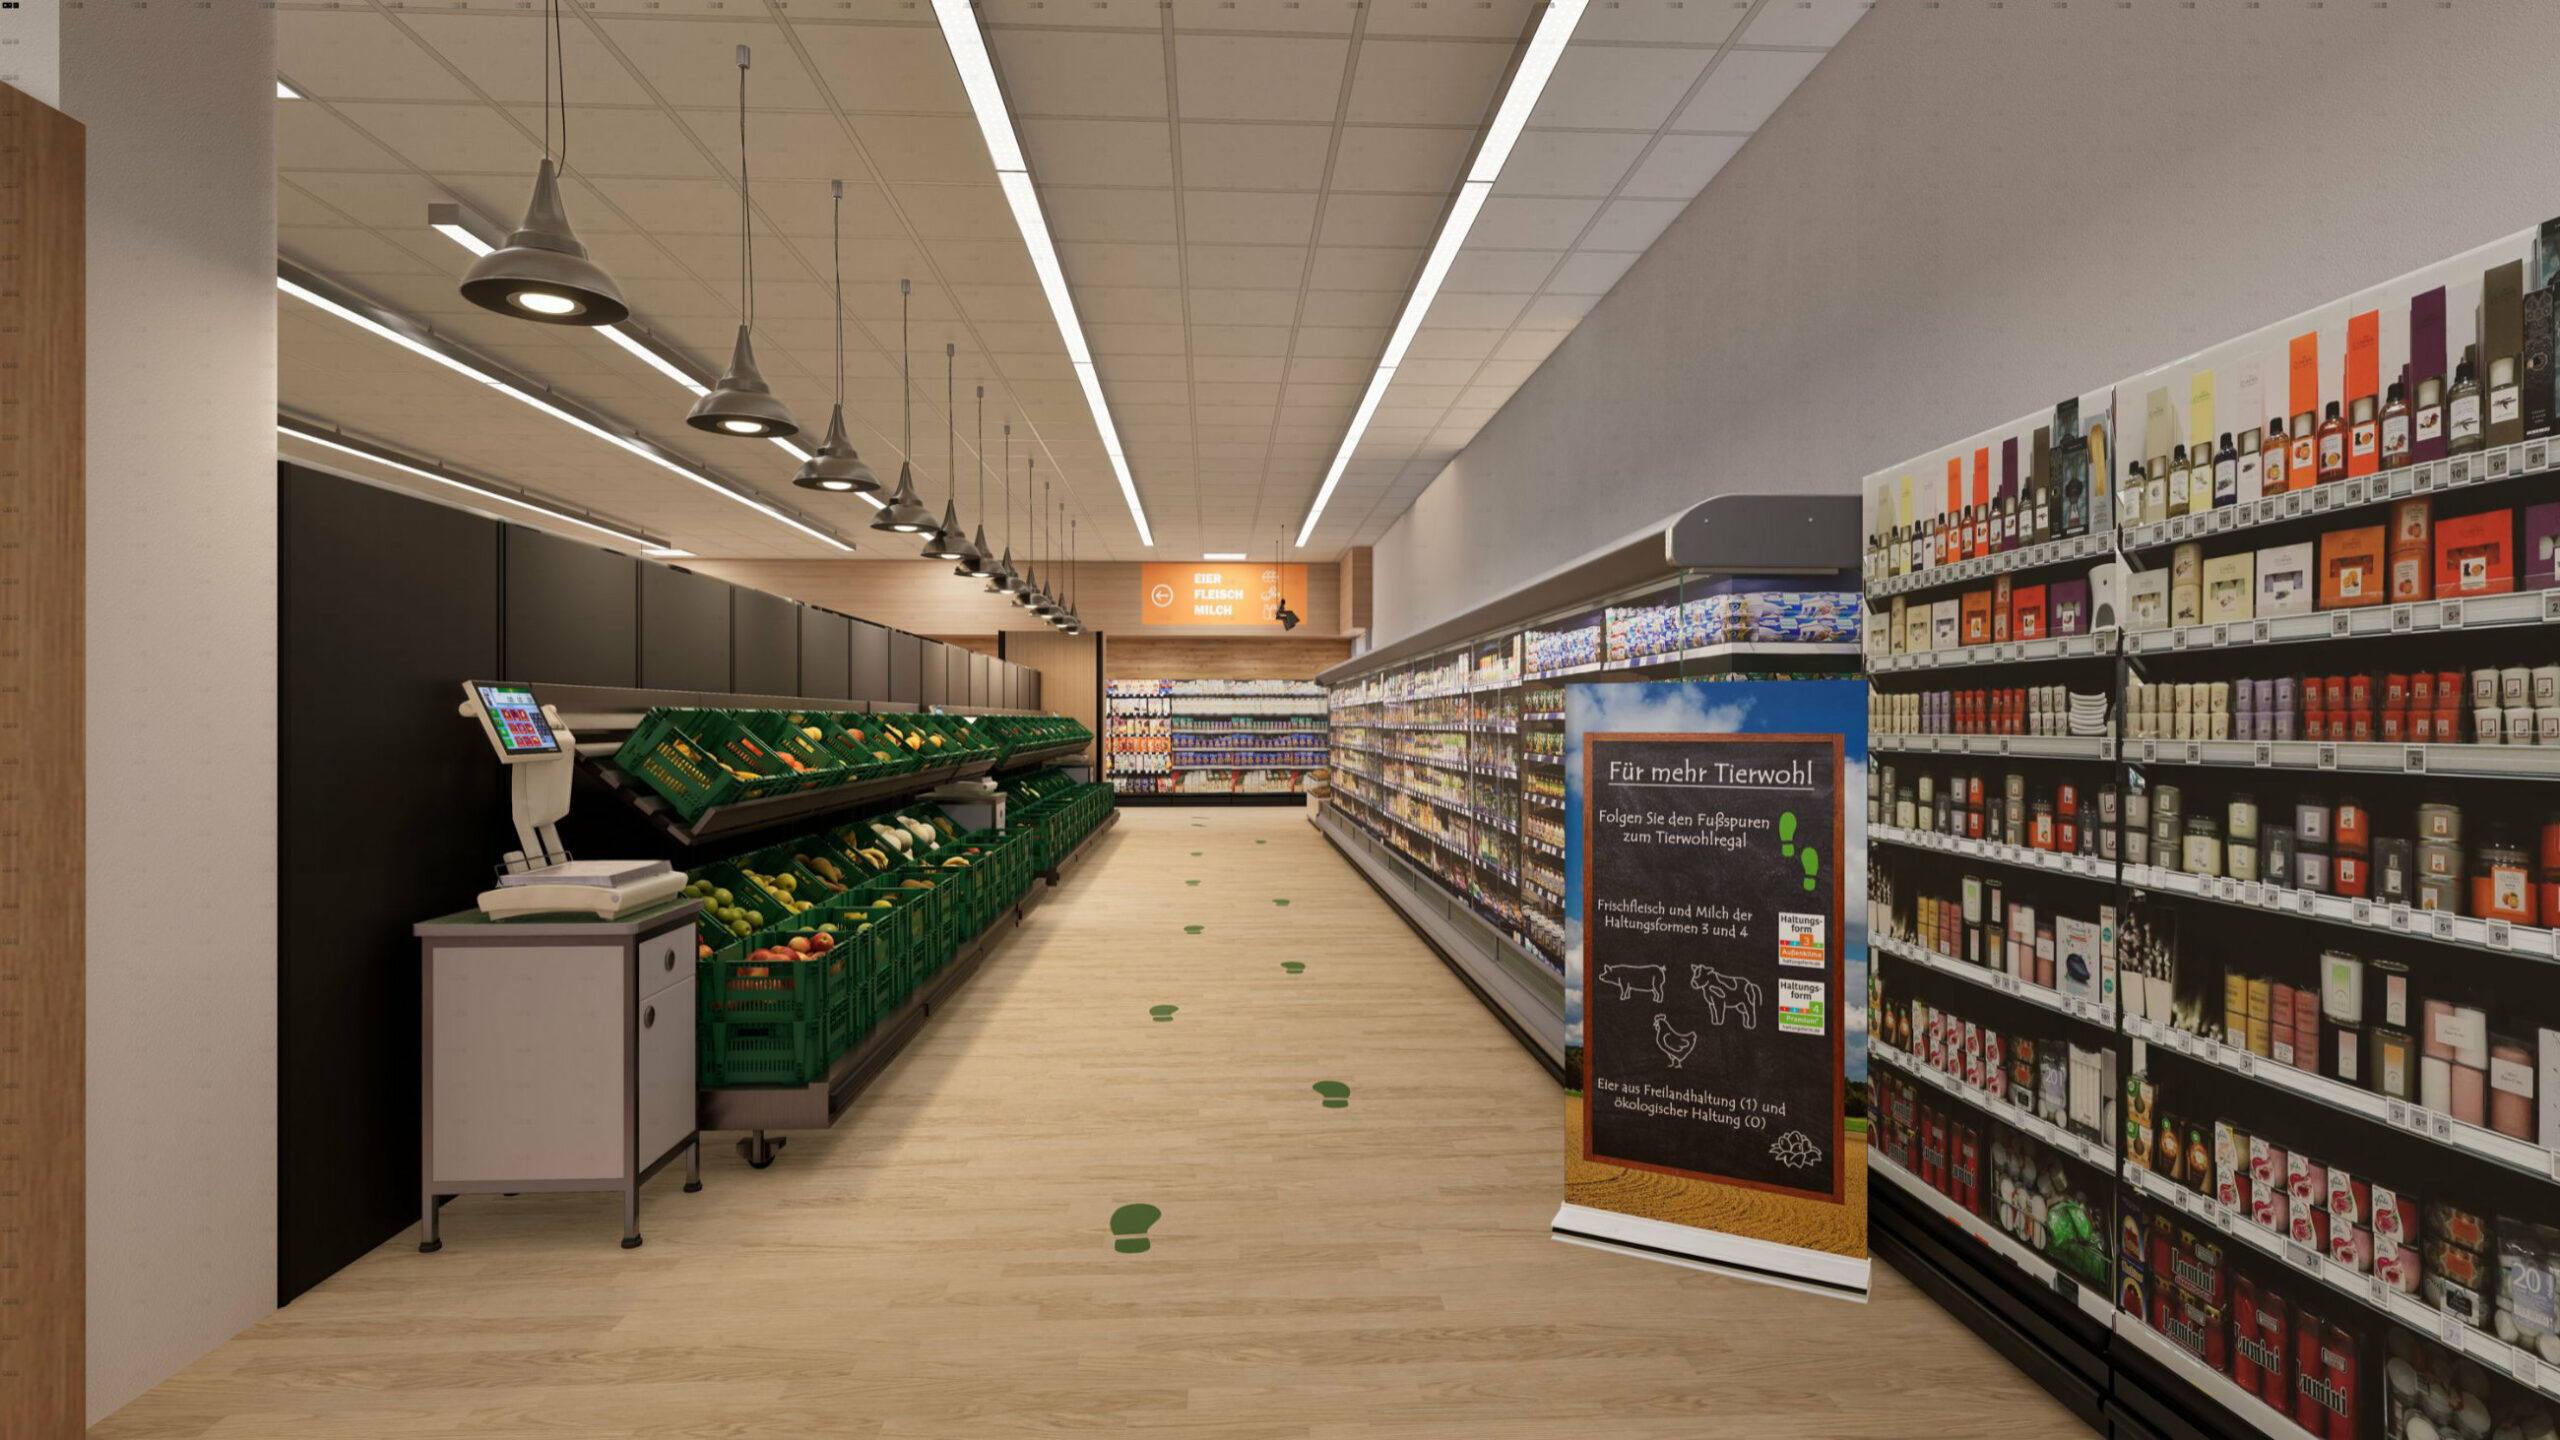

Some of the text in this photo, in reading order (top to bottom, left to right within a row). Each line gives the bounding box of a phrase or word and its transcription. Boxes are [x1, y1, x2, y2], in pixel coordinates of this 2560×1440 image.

[1194, 573, 1222, 585] EIER
[1194, 589, 1244, 600] FLEISCH
[1194, 605, 1233, 616] MILCH
[1609, 758, 1813, 786] Für mehr Tierwohl
[1599, 808, 1770, 833] Folgen Sie den Fußspuren
[1623, 828, 1747, 852] zum Tierwohlregal
[1597, 899, 1753, 921] Frischfleisch und Milch der
[1605, 914, 1749, 938] Haltungsformen 3 und 4
[1780, 915, 1823, 926] Haltungs-
[1791, 925, 1813, 934] form
[1803, 936, 1810, 946] 3
[1780, 981, 1823, 993] Haltungs-
[1790, 991, 1812, 1000] form
[1813, 1004, 1820, 1013] 4
[1597, 1077, 1786, 1116] Eier aus Freilandhaltung (1) und
[1614, 1095, 1689, 1117] ökologischer
[1692, 1107, 1740, 1129] Haltung
[2512, 1262, 2541, 1294] 20
